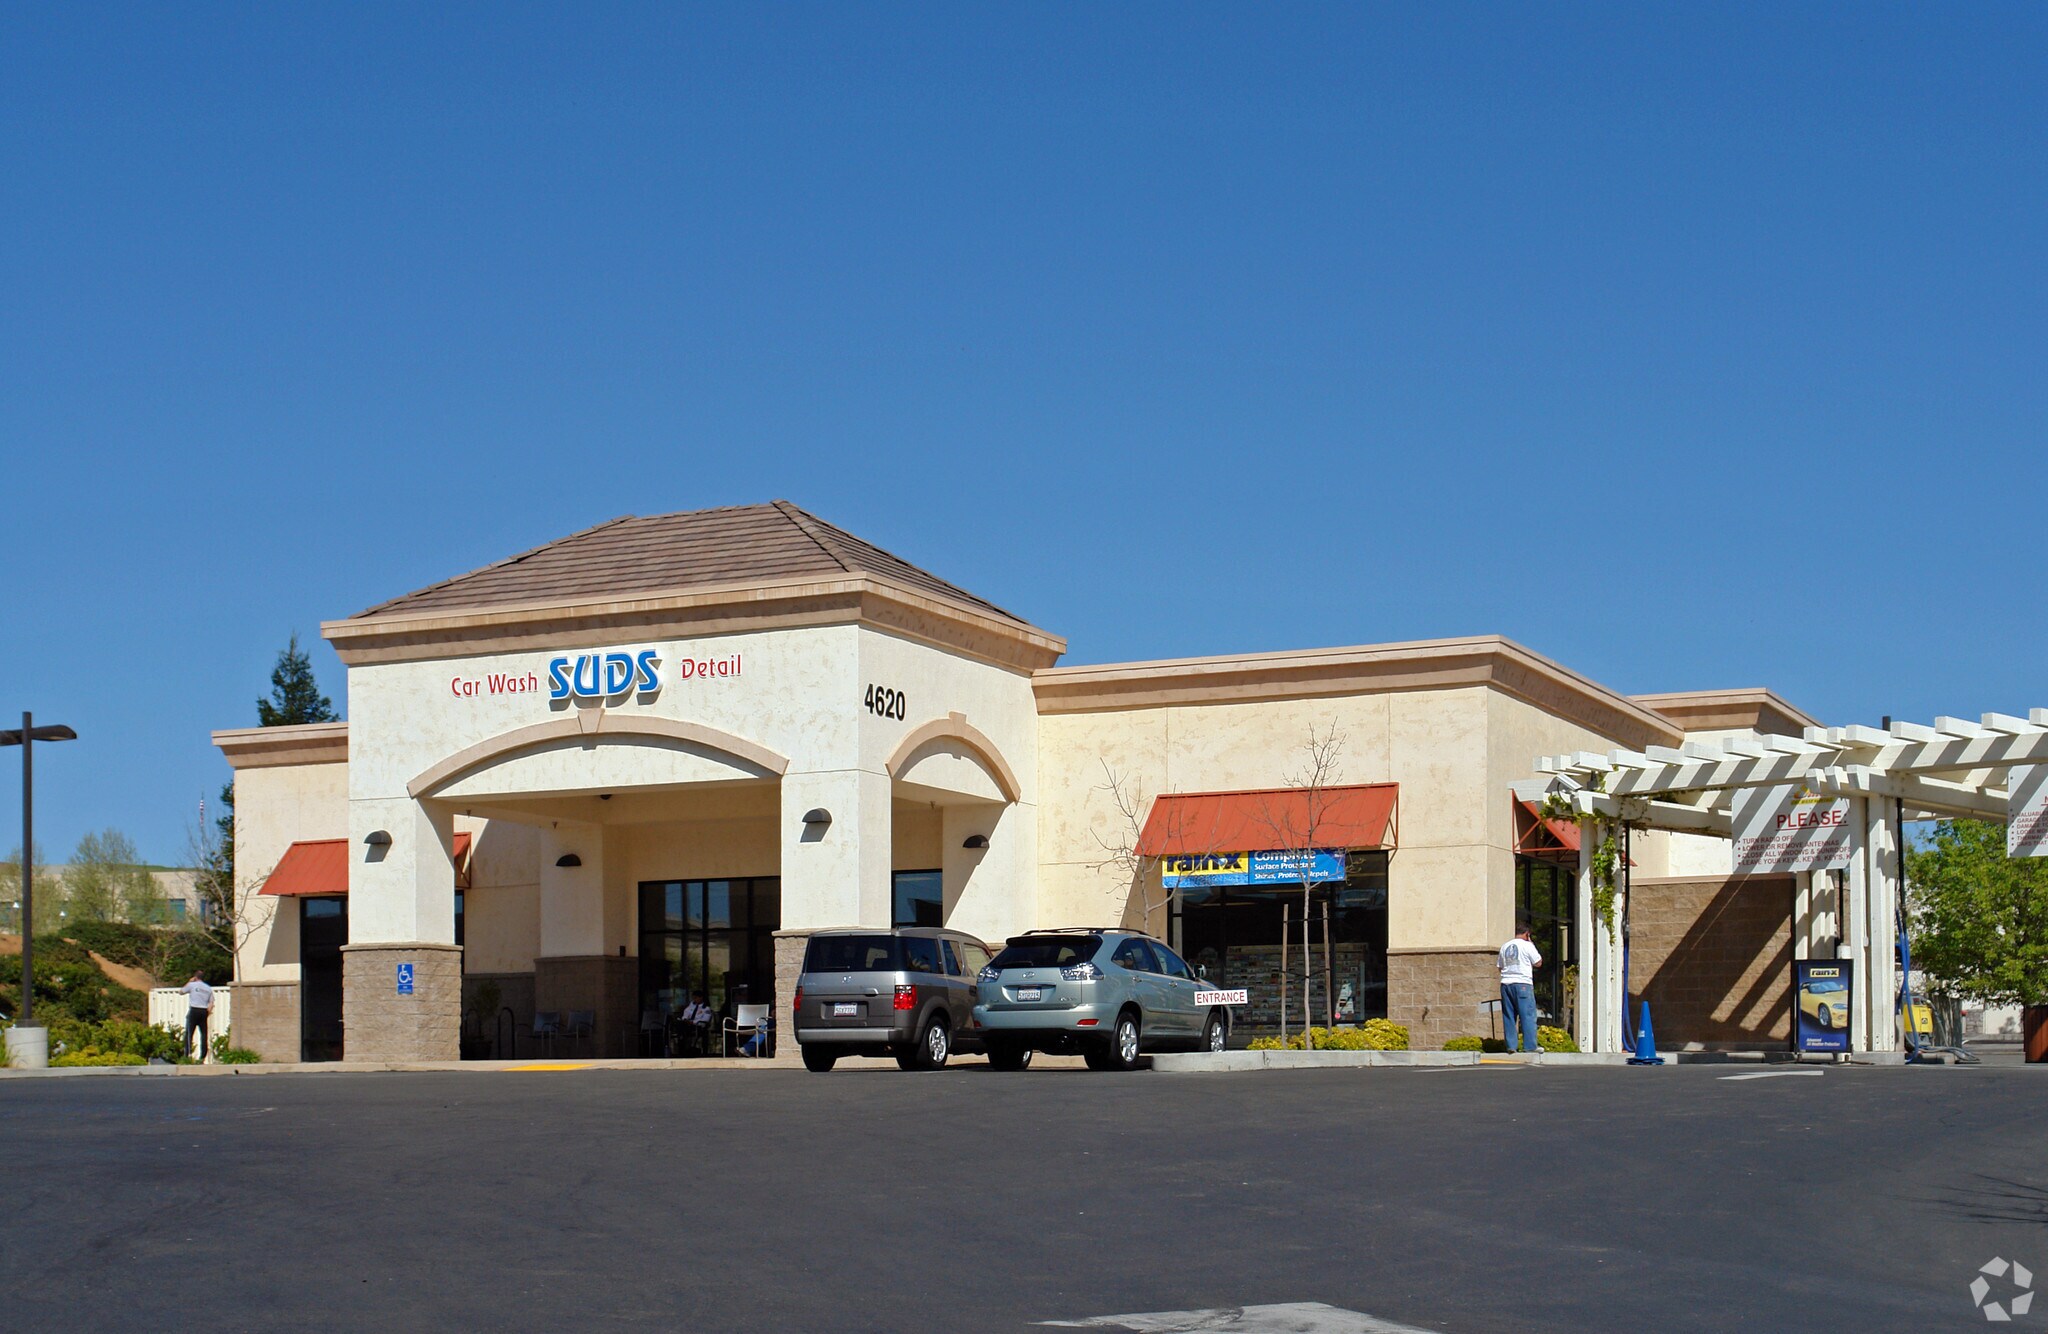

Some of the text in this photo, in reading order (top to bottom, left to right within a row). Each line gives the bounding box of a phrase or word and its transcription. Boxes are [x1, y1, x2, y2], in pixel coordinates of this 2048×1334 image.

[451, 649, 741, 699] Car Wash SUDS Detail
[864, 683, 905, 721] 4620
[1777, 810, 1847, 828] PLEASE:
[1761, 835, 1780, 843] RADIO
[1742, 843, 1767, 851] LOWER
[1777, 841, 1803, 849] REMOVE
[1805, 840, 1839, 848] ANTENNAS
[1765, 849, 1776, 857] ALL
[1777, 848, 1809, 857] WINDOWS
[1742, 857, 1761, 866] LEAVE
[1764, 856, 1781, 864] YOUR
[1196, 992, 1245, 1004] ENTRANCE
